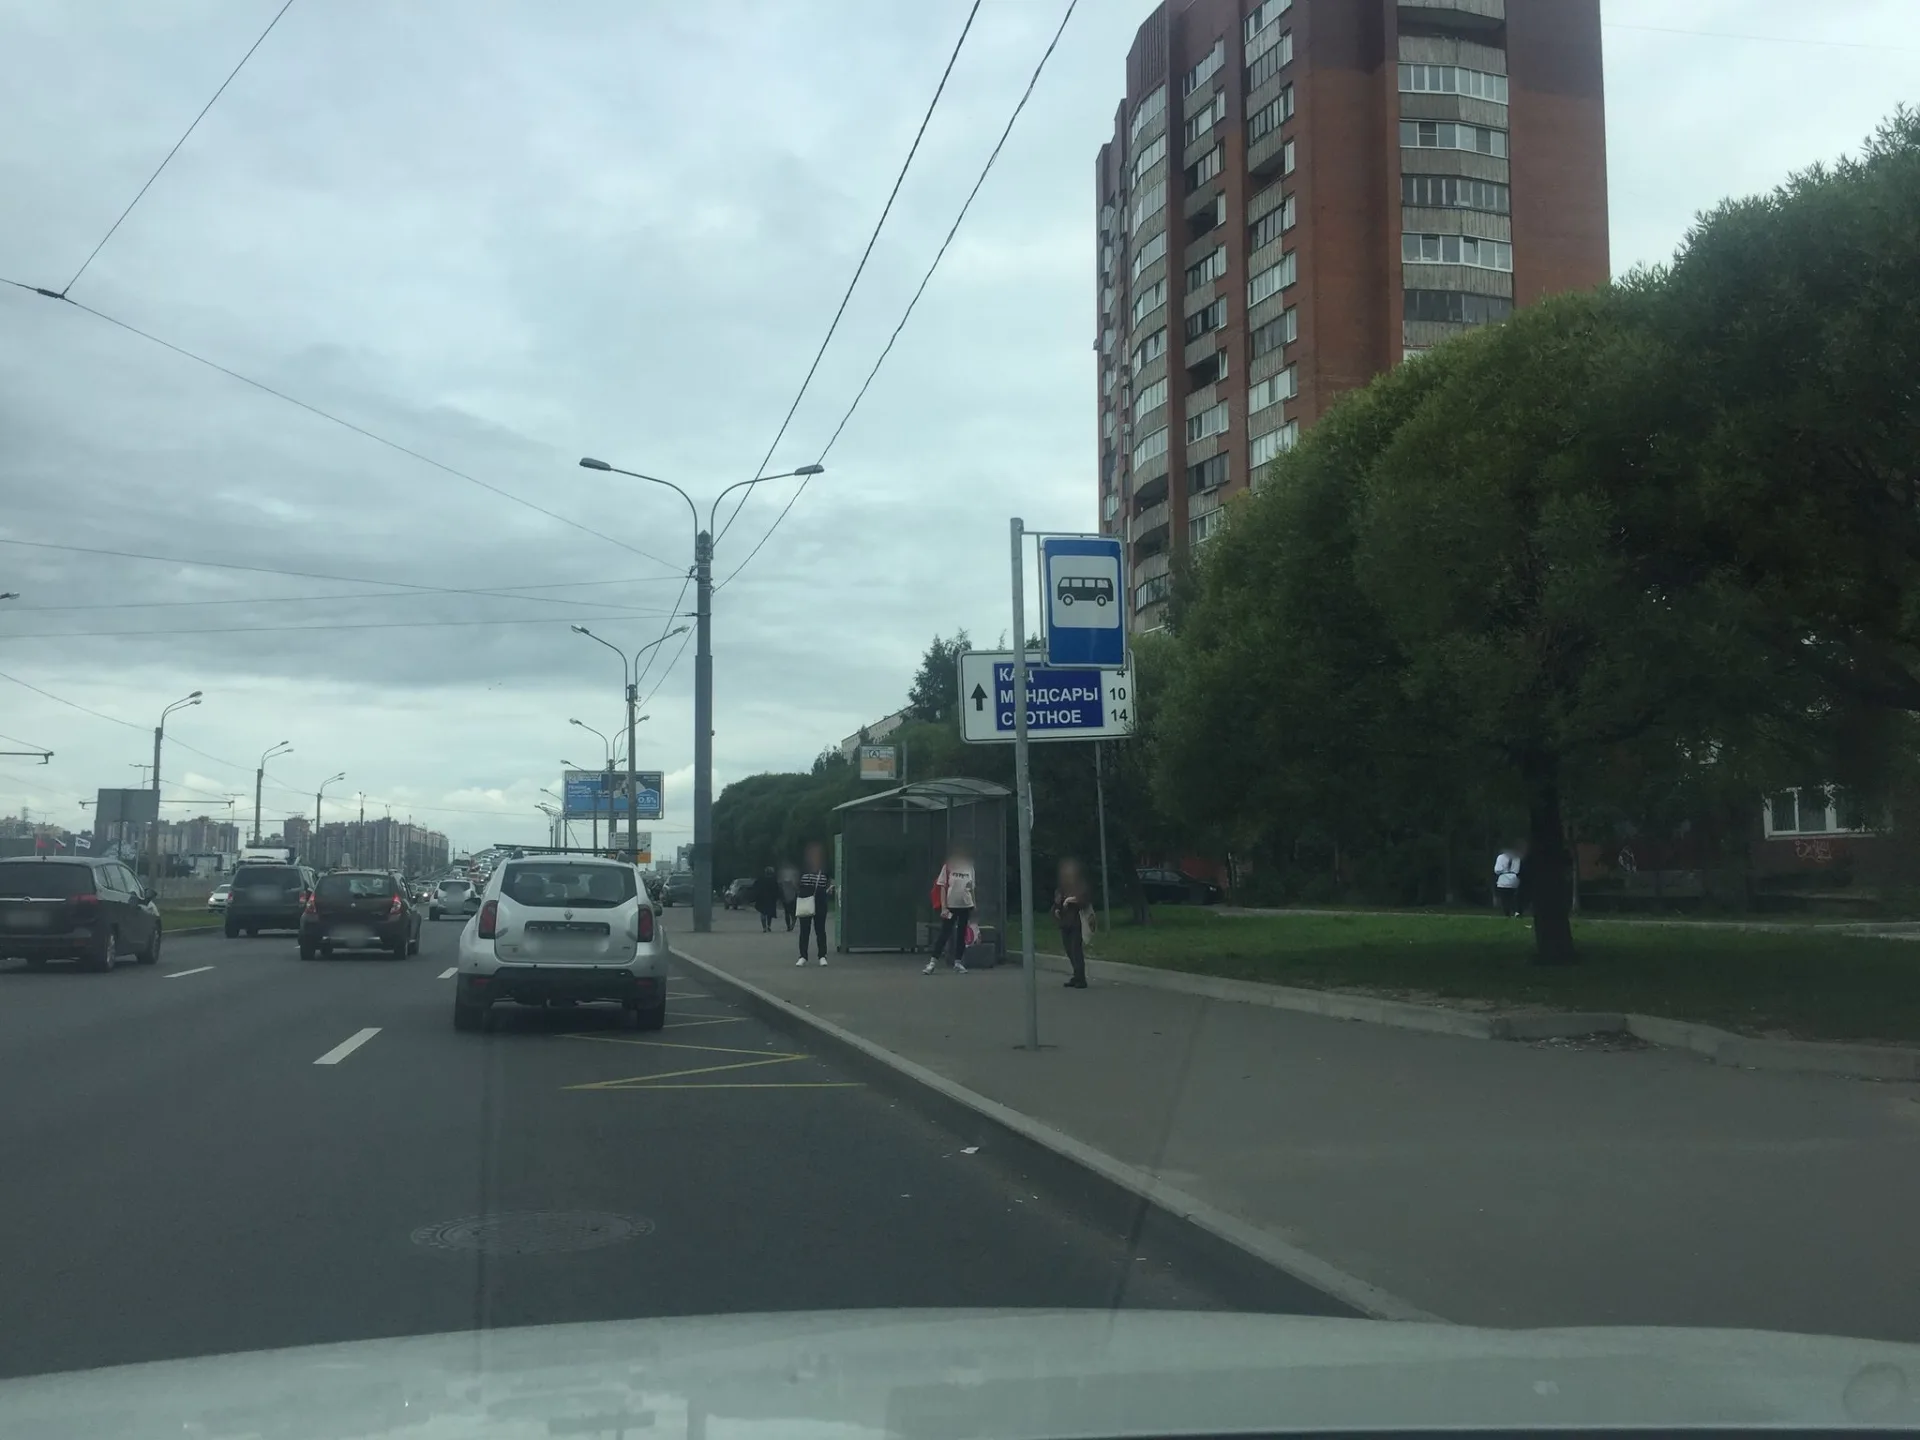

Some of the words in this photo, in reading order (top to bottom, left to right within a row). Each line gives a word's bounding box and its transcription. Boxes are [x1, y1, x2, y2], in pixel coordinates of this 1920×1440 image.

[1000, 687, 1098, 705] МНДСАРЫ
[1110, 687, 1126, 700] 10
[1001, 710, 1082, 726] СОТНОЕ
[1111, 709, 1128, 721] 14
